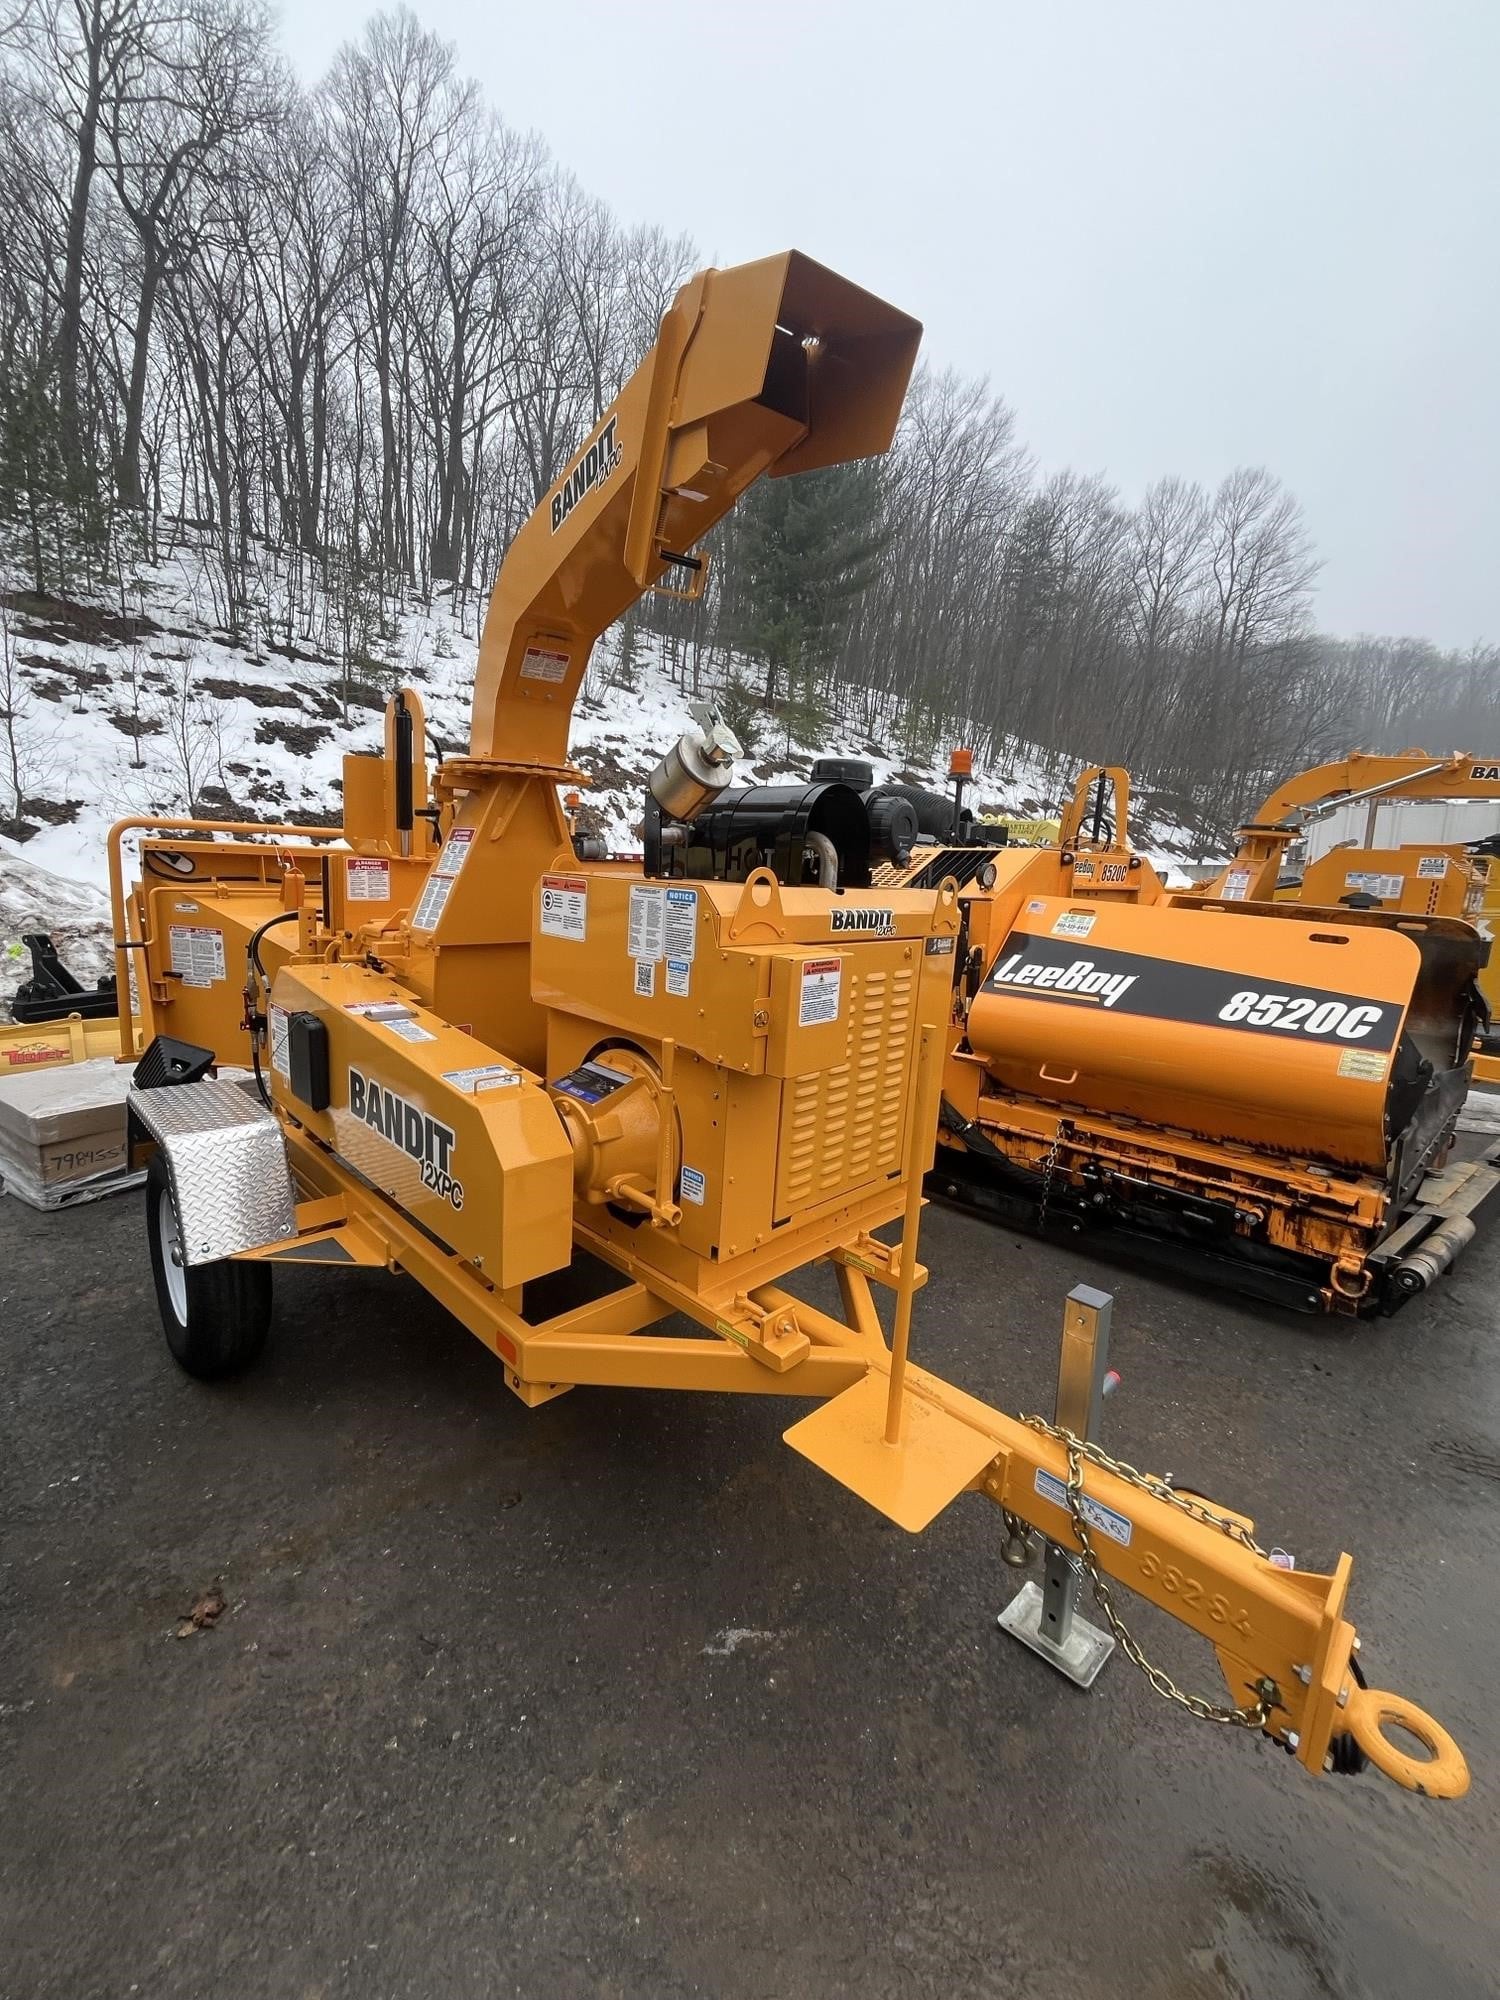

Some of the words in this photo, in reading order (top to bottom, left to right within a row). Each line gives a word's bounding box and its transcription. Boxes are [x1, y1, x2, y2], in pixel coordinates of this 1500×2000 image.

[551, 414, 617, 535] BANDIT
[1073, 858, 1096, 879] eeBoy
[1101, 864, 1128, 882] 8520C
[669, 891, 693, 901] NOTICE
[831, 908, 893, 931] BANDIT
[874, 925, 897, 937] 12XPC
[669, 962, 687, 970] NOTICE
[993, 953, 1140, 1008] LeeBoy
[1218, 991, 1383, 1039] 8520C
[349, 1067, 455, 1175] BANDIT
[418, 1158, 464, 1210] 12XPC
